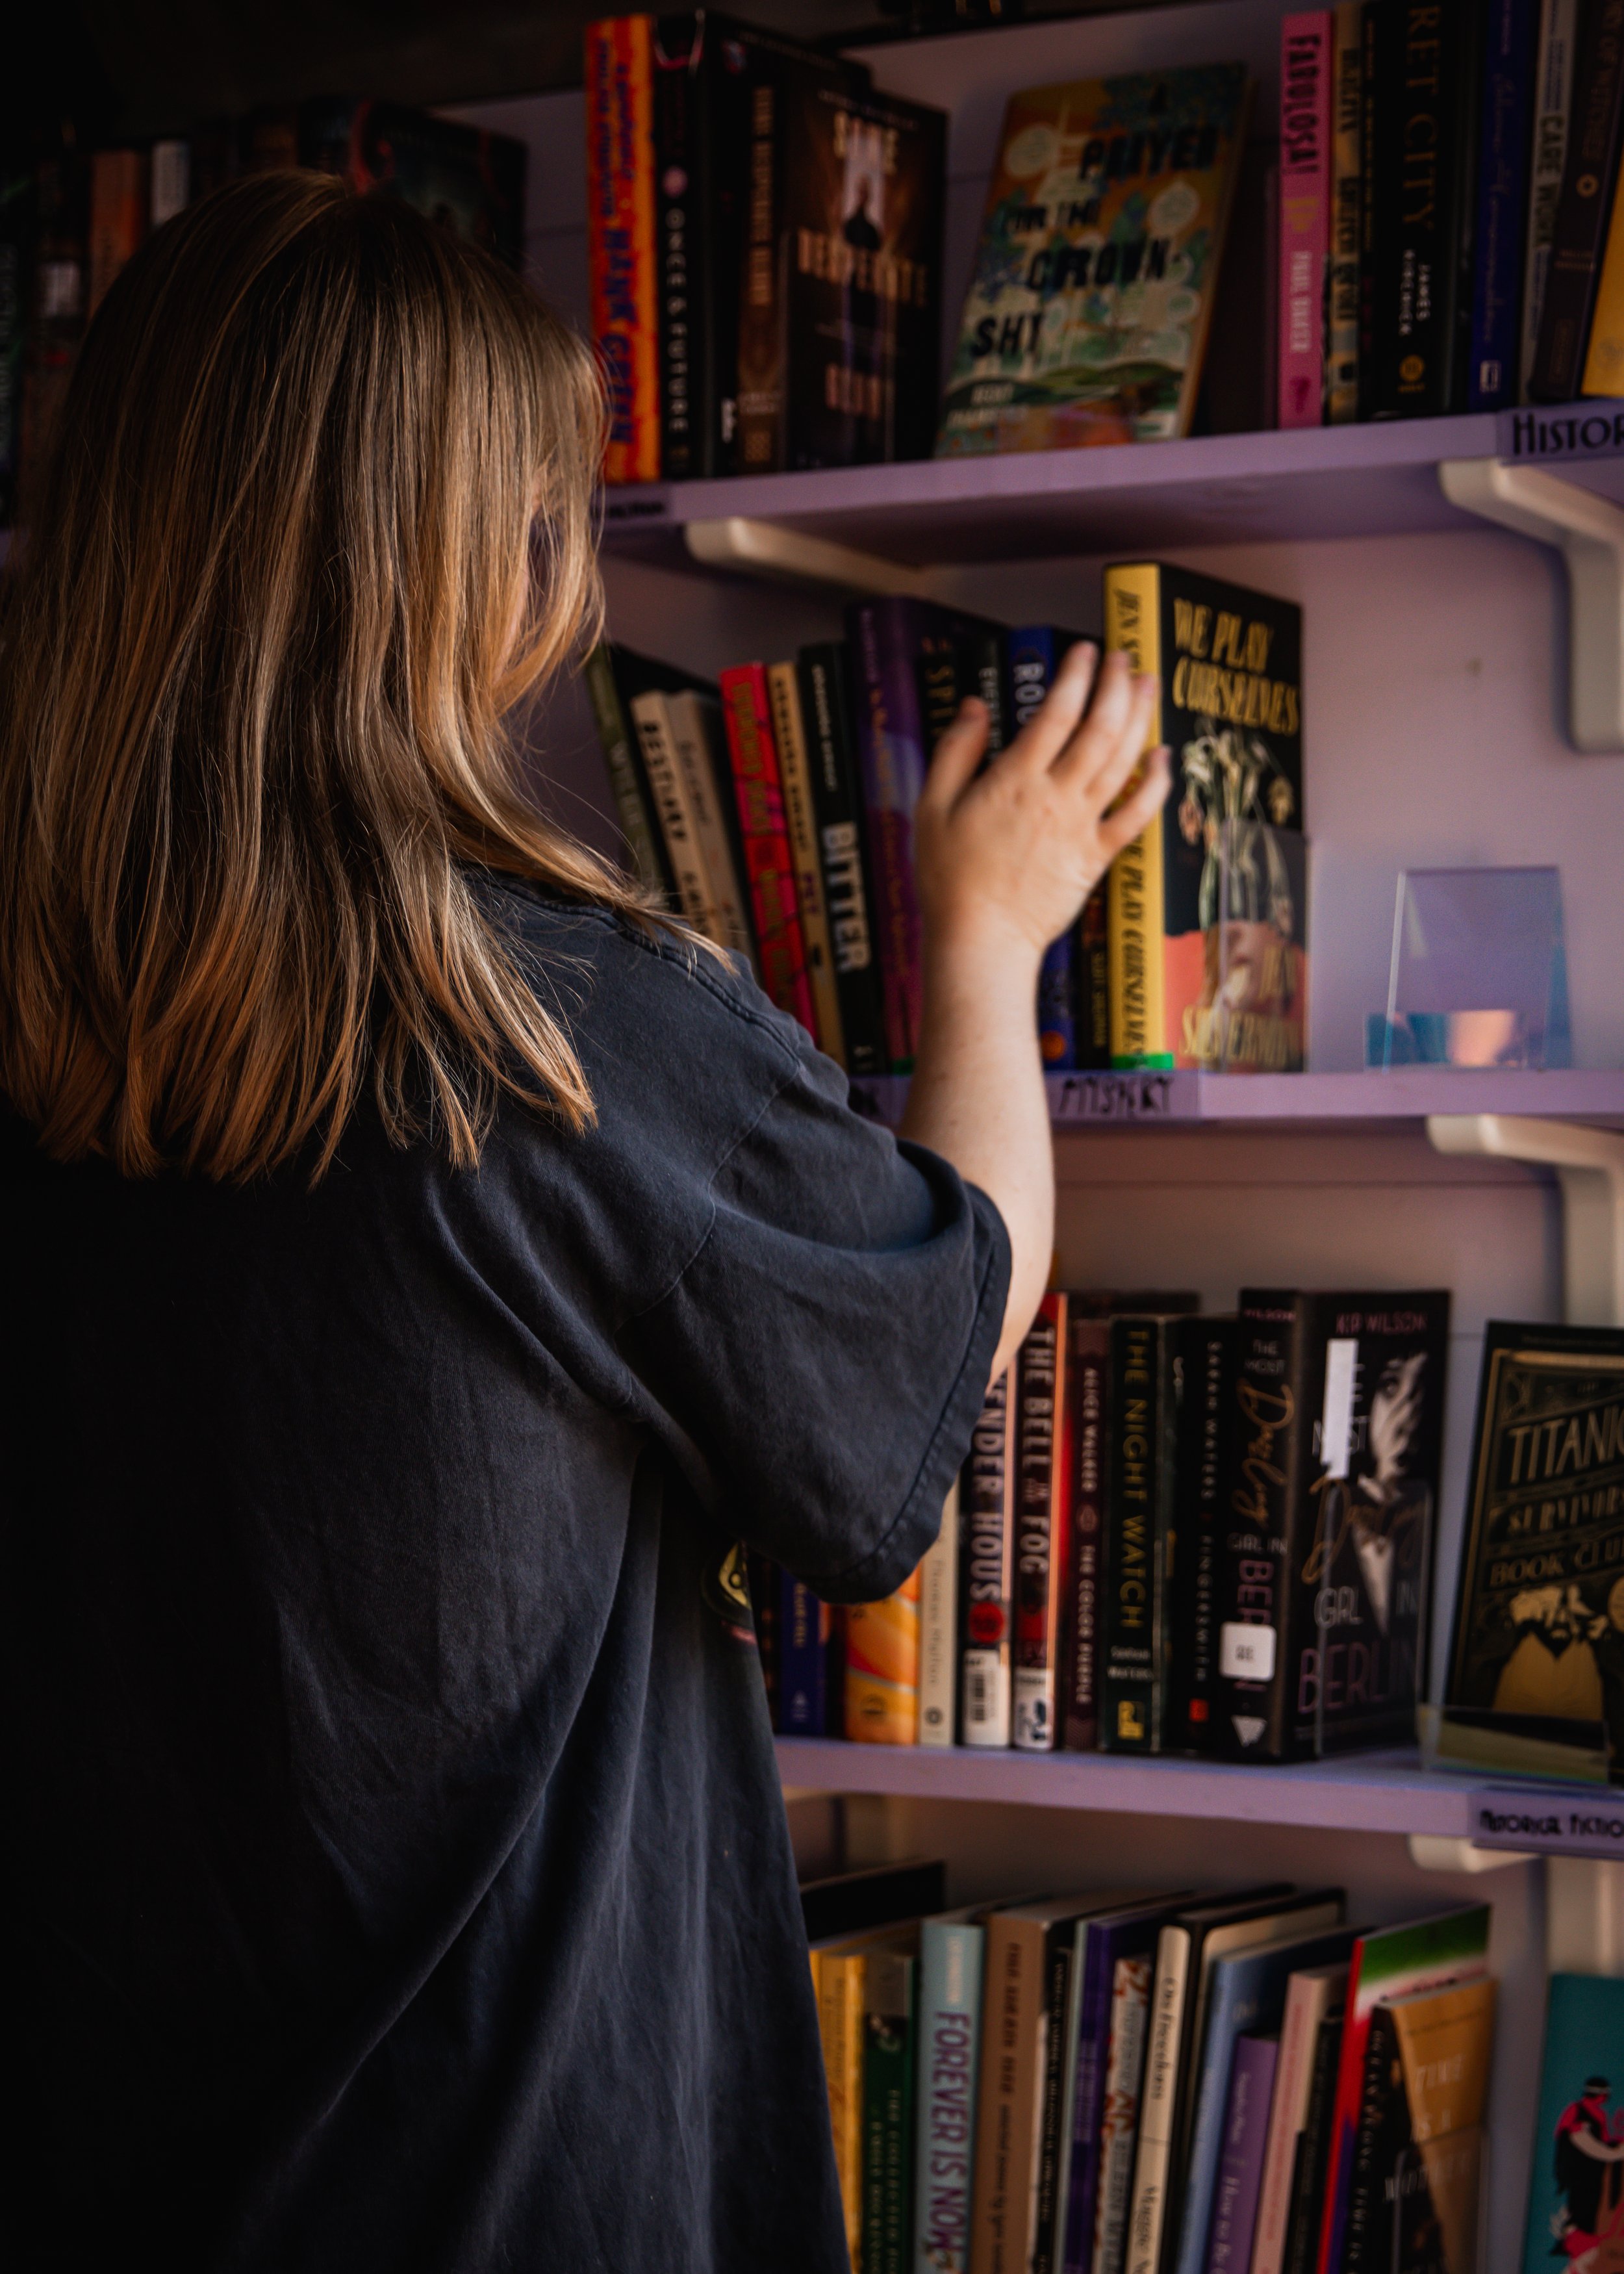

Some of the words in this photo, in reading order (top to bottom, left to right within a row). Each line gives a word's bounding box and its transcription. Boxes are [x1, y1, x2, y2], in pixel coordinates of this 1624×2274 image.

[1402, 112, 1440, 231] CITY
[666, 207, 687, 288] ONCE
[666, 296, 688, 317] &
[667, 321, 689, 433] FUTURE
[642, 719, 688, 837] BESTIARY
[821, 820, 872, 973] BITTER
[1023, 1326, 1056, 1386] THE
[1123, 1328, 1151, 1386] THE
[1365, 1310, 1429, 1335] WILSON
[1082, 1366, 1100, 1421] ALICE
[1206, 1340, 1224, 1411] SARAH
[1021, 1396, 1054, 1471] BELL
[1080, 1424, 1098, 1493] WALKER
[1122, 1398, 1150, 1503] NIGHT
[1200, 1417, 1221, 1501] WATERS
[1019, 1514, 1050, 1575] FOG
[1078, 1544, 1097, 1576] THE
[1119, 1513, 1148, 1629] WATCH
[1489, 1550, 1567, 1588] BOOK
[1076, 1578, 1096, 1639] COLOR
[1193, 1535, 1216, 1682] FINGERSMITH
[1074, 1642, 1094, 1705] PURPLE
[1297, 1639, 1417, 1717] BERLIN
[932, 2012, 972, 2143] FOREVER
[929, 2150, 968, 2178] IS
[926, 2184, 967, 2253] NOW
